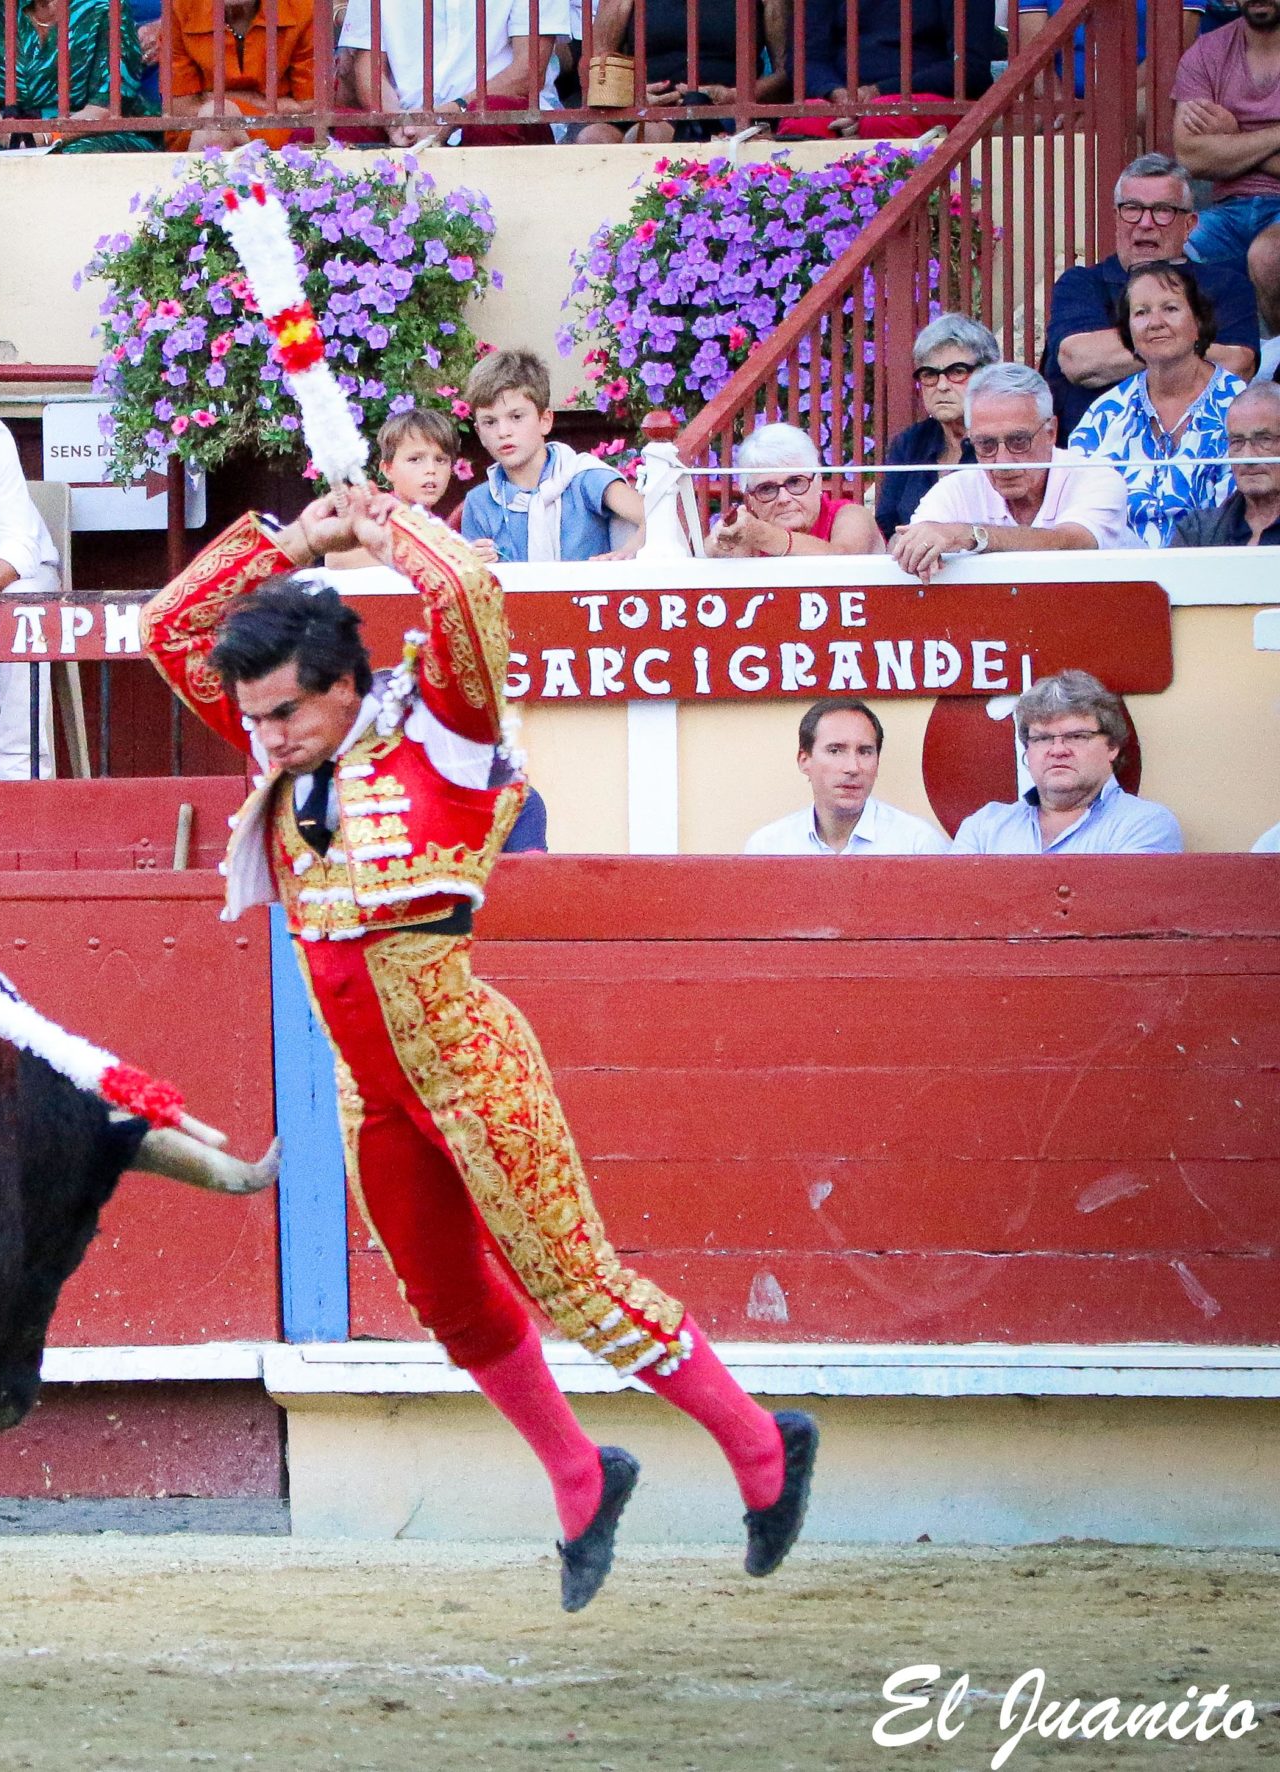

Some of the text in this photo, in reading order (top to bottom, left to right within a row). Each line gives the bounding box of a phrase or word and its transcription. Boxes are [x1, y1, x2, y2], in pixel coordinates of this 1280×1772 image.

[50, 445, 92, 458] SENS
[571, 591, 868, 632] TOROS DE
